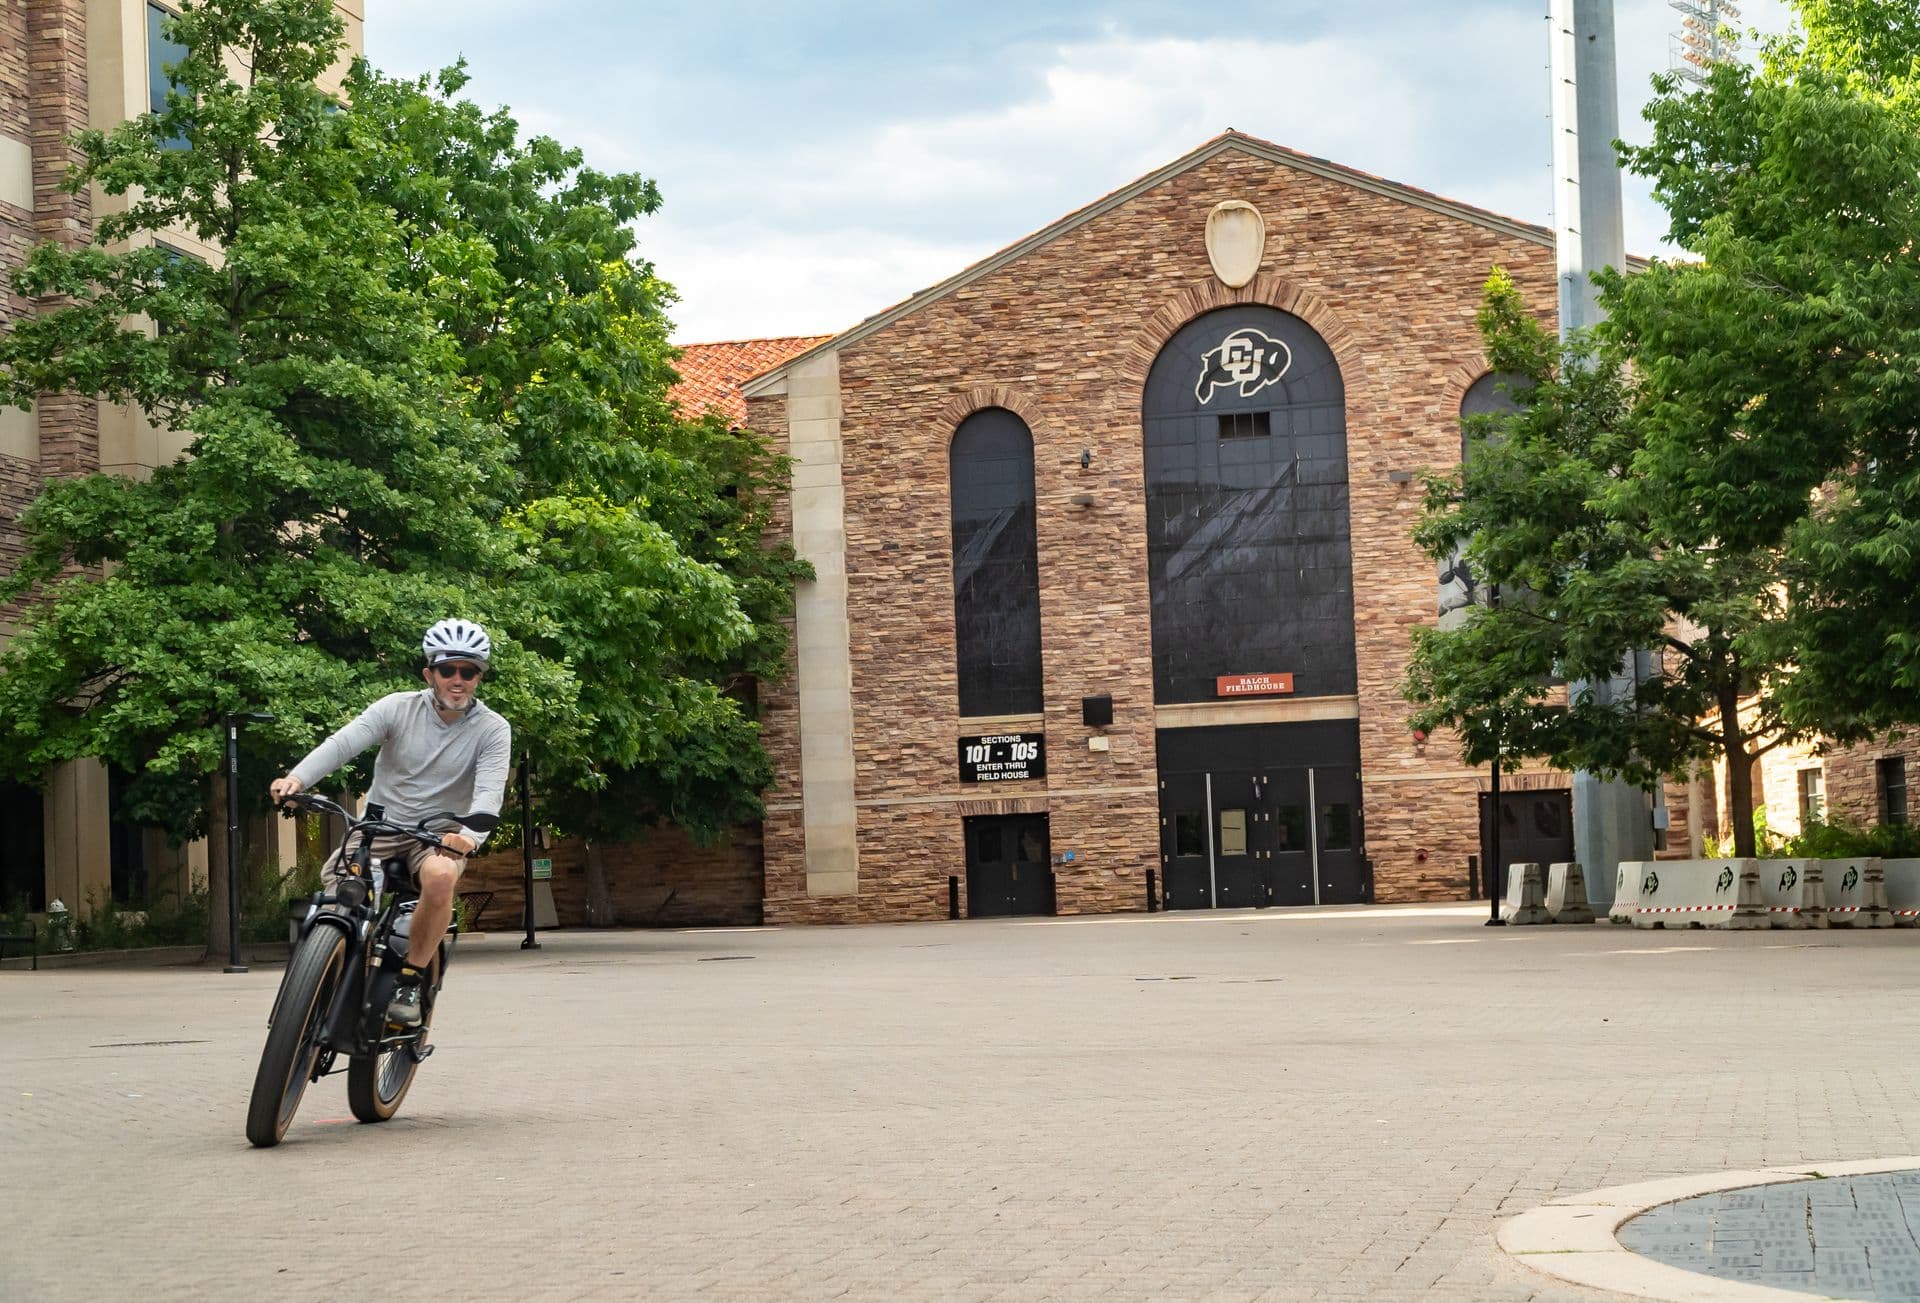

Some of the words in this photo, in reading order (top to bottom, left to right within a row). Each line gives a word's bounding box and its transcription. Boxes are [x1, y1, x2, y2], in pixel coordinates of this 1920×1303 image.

[1221, 338, 1263, 381] CU
[1240, 677, 1269, 685] BALCH
[1226, 683, 1284, 692] FIELDHOUSE
[981, 735, 1021, 744] SECTIONS
[966, 745, 991, 763] 101
[1011, 742, 1038, 760] 105
[977, 763, 1003, 771] ENTER
[1001, 771, 1029, 779] HOUSE
